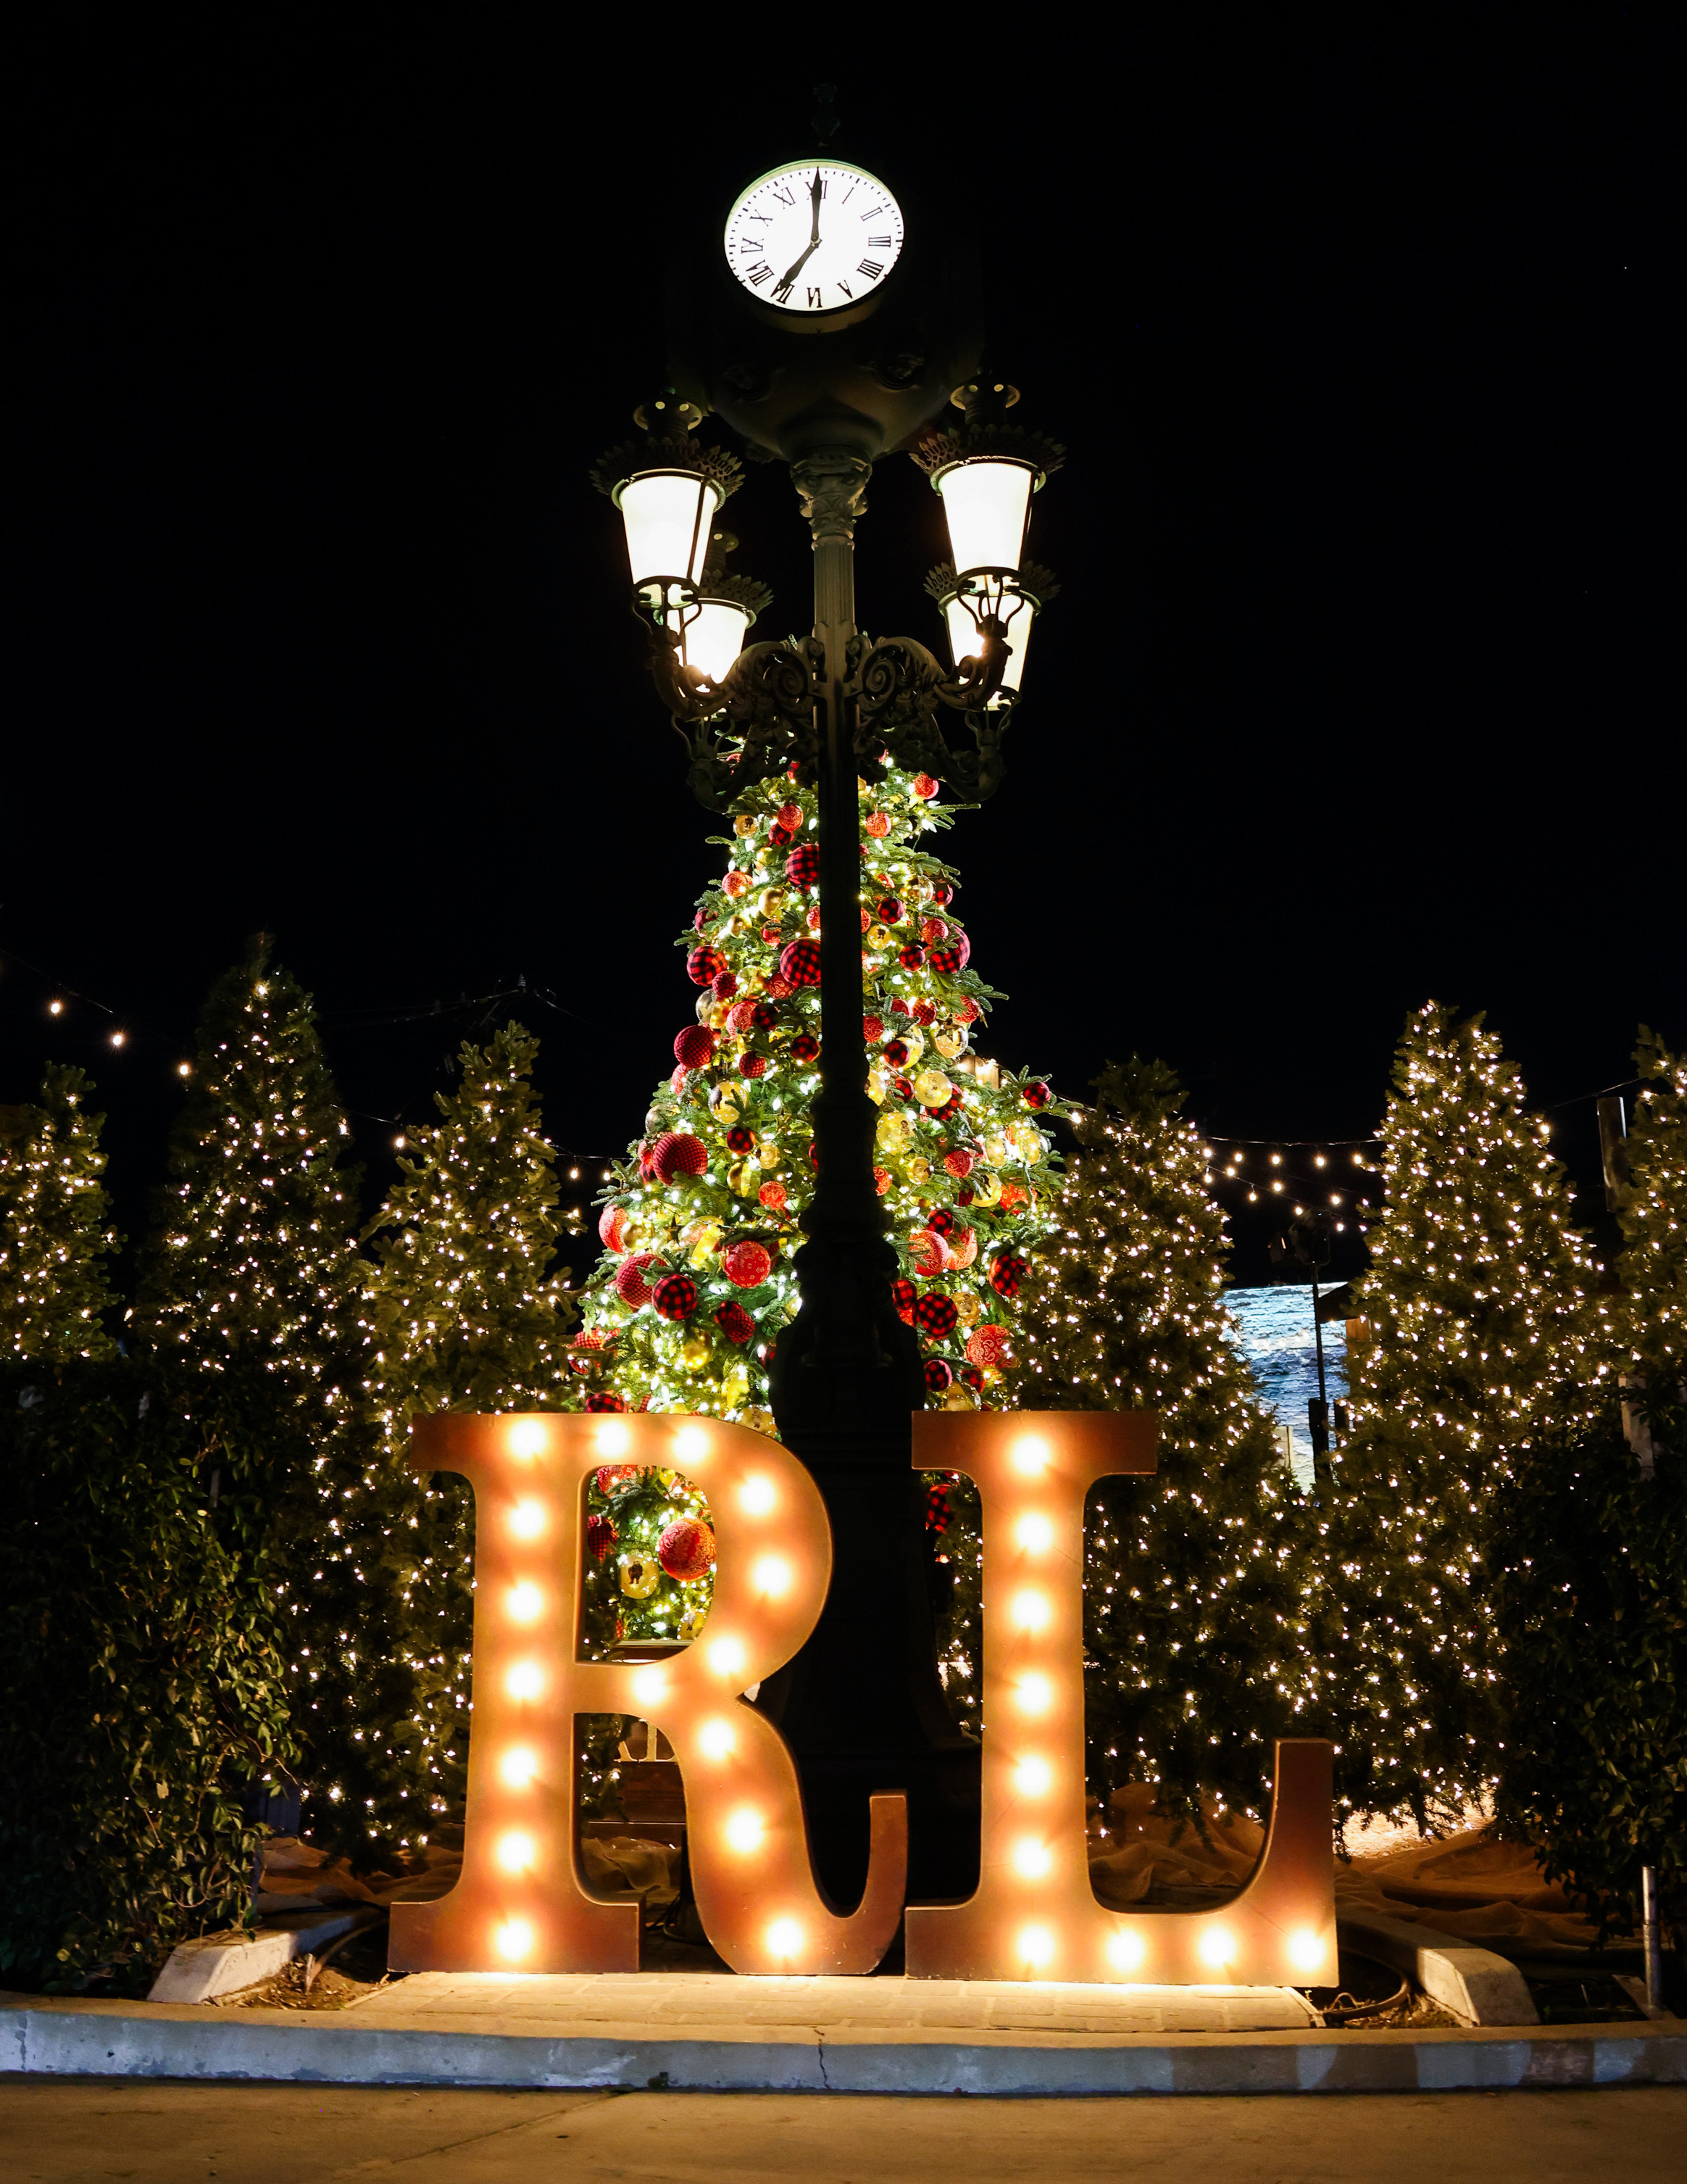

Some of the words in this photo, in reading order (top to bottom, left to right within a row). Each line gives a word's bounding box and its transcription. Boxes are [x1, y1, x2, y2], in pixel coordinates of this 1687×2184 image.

[772, 187, 796, 209] XI
[842, 187, 854, 204] I
[749, 209, 773, 226] X
[860, 207, 883, 221] II
[741, 238, 764, 254] IX
[868, 236, 891, 247] III
[746, 260, 775, 286] VIII
[857, 259, 884, 281] IIII
[807, 288, 822, 307] VI
[837, 280, 853, 299] V
[388, 1411, 1339, 1987] RL
